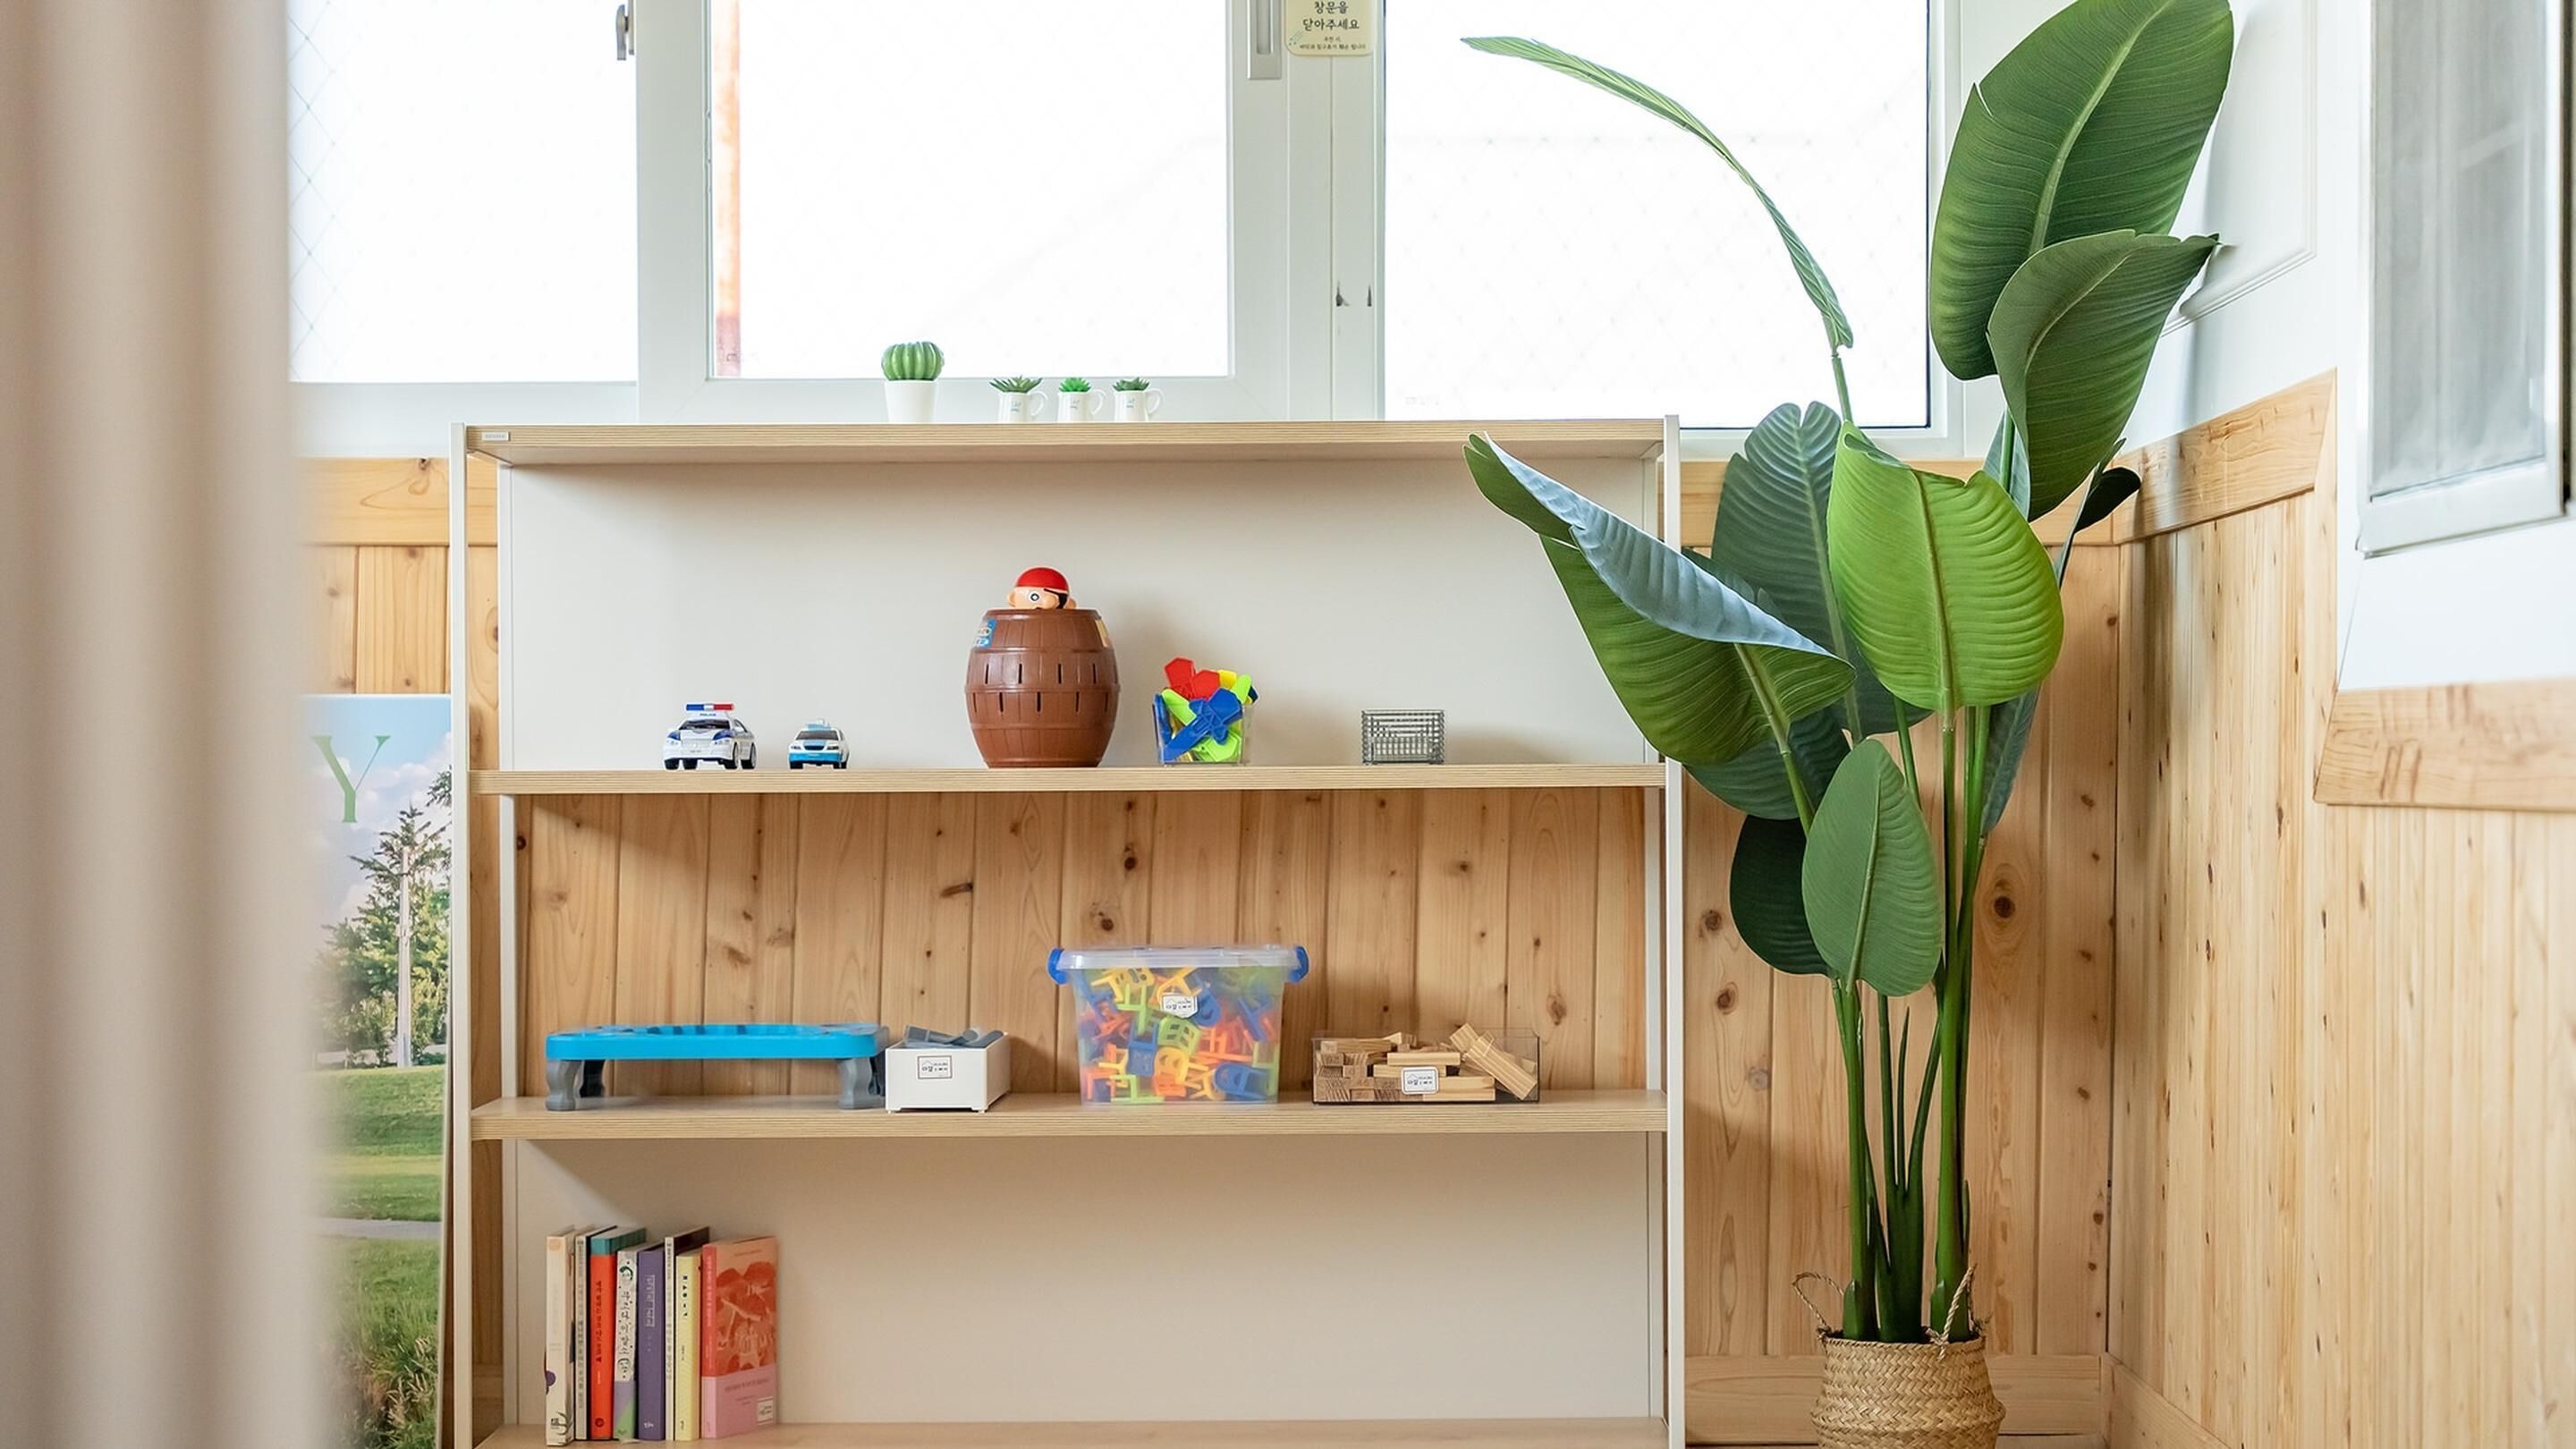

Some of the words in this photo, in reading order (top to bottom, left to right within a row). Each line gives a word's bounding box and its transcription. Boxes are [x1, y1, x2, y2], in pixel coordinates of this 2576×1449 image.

[1315, 1, 1348, 13] 창문을
[1302, 18, 1360, 31] 닫아주세요
[311, 735, 391, 823] Y
